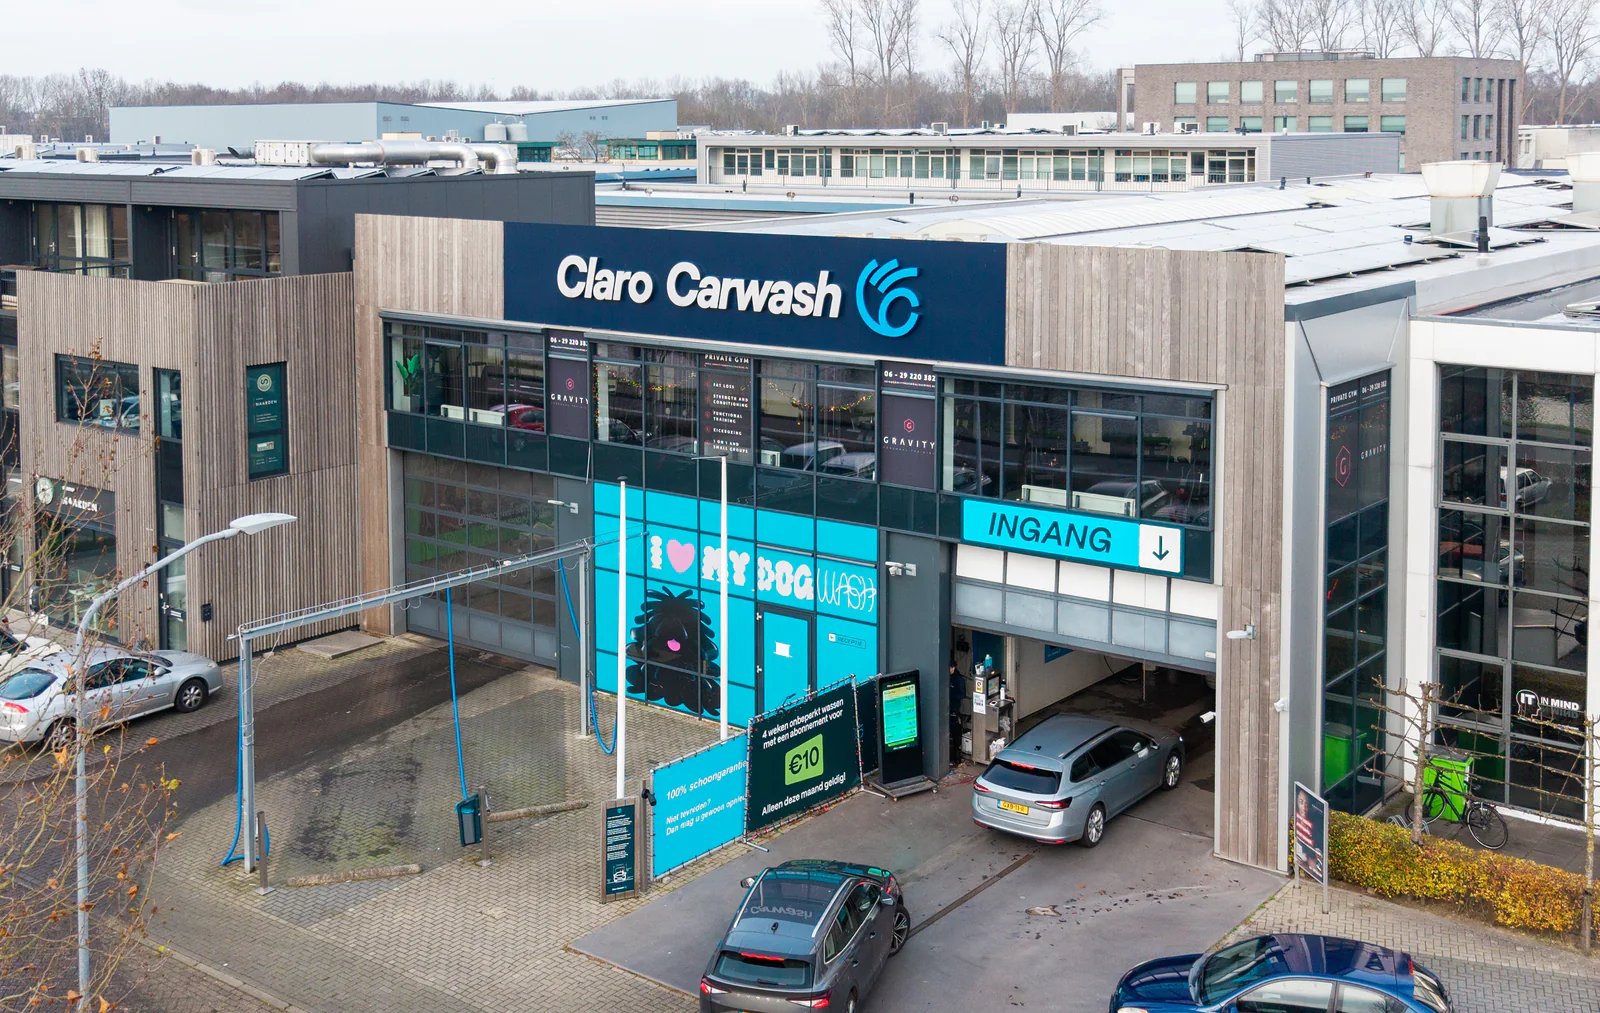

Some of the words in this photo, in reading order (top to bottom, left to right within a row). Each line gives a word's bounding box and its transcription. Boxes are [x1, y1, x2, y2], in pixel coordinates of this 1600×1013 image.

[557, 254, 654, 304] Claro
[666, 261, 842, 318] Carwash
[704, 353, 733, 363] PRIVATE
[734, 357, 750, 365] GYM
[923, 374, 936, 382] 382
[550, 393, 589, 405] GRAVITY
[713, 400, 749, 408] CONDITIONING
[1330, 391, 1348, 404] PRIVATE
[1348, 388, 1358, 400] GYM
[713, 411, 743, 419] FUNCTIONAL
[713, 416, 736, 424] TRAINING
[713, 428, 742, 436] KICKBOXING
[883, 436, 936, 450] GRAVITY
[1361, 443, 1387, 460] GRAVITY
[1339, 456, 1347, 476] G
[989, 512, 1112, 553] INGANG
[650, 535, 663, 570] I
[702, 545, 751, 587] MY
[757, 556, 814, 600] DOG
[817, 567, 877, 612] WASH
[837, 636, 863, 647] RECEPTIE
[1520, 693, 1536, 705] IT
[1540, 696, 1549, 706] IN
[1550, 698, 1580, 711] MIND
[761, 729, 768, 739] 4
[768, 722, 789, 738] weken
[789, 709, 822, 728] onbeperkt
[821, 698, 844, 713] wassen
[763, 739, 777, 750] met
[777, 733, 790, 743] een
[789, 715, 829, 740] abonnement
[828, 709, 843, 721] voor
[788, 746, 820, 775] €10
[666, 784, 688, 801] 100%
[689, 760, 748, 792] schoongarantie
[761, 800, 783, 816] Alleen
[783, 794, 801, 807] deze
[800, 781, 824, 799] maand
[824, 771, 847, 791] geldig!
[666, 813, 679, 825] Niet
[680, 798, 711, 819] tevreden?
[666, 825, 679, 836] Dan
[680, 817, 694, 829] mag
[700, 803, 725, 822] gewoon
